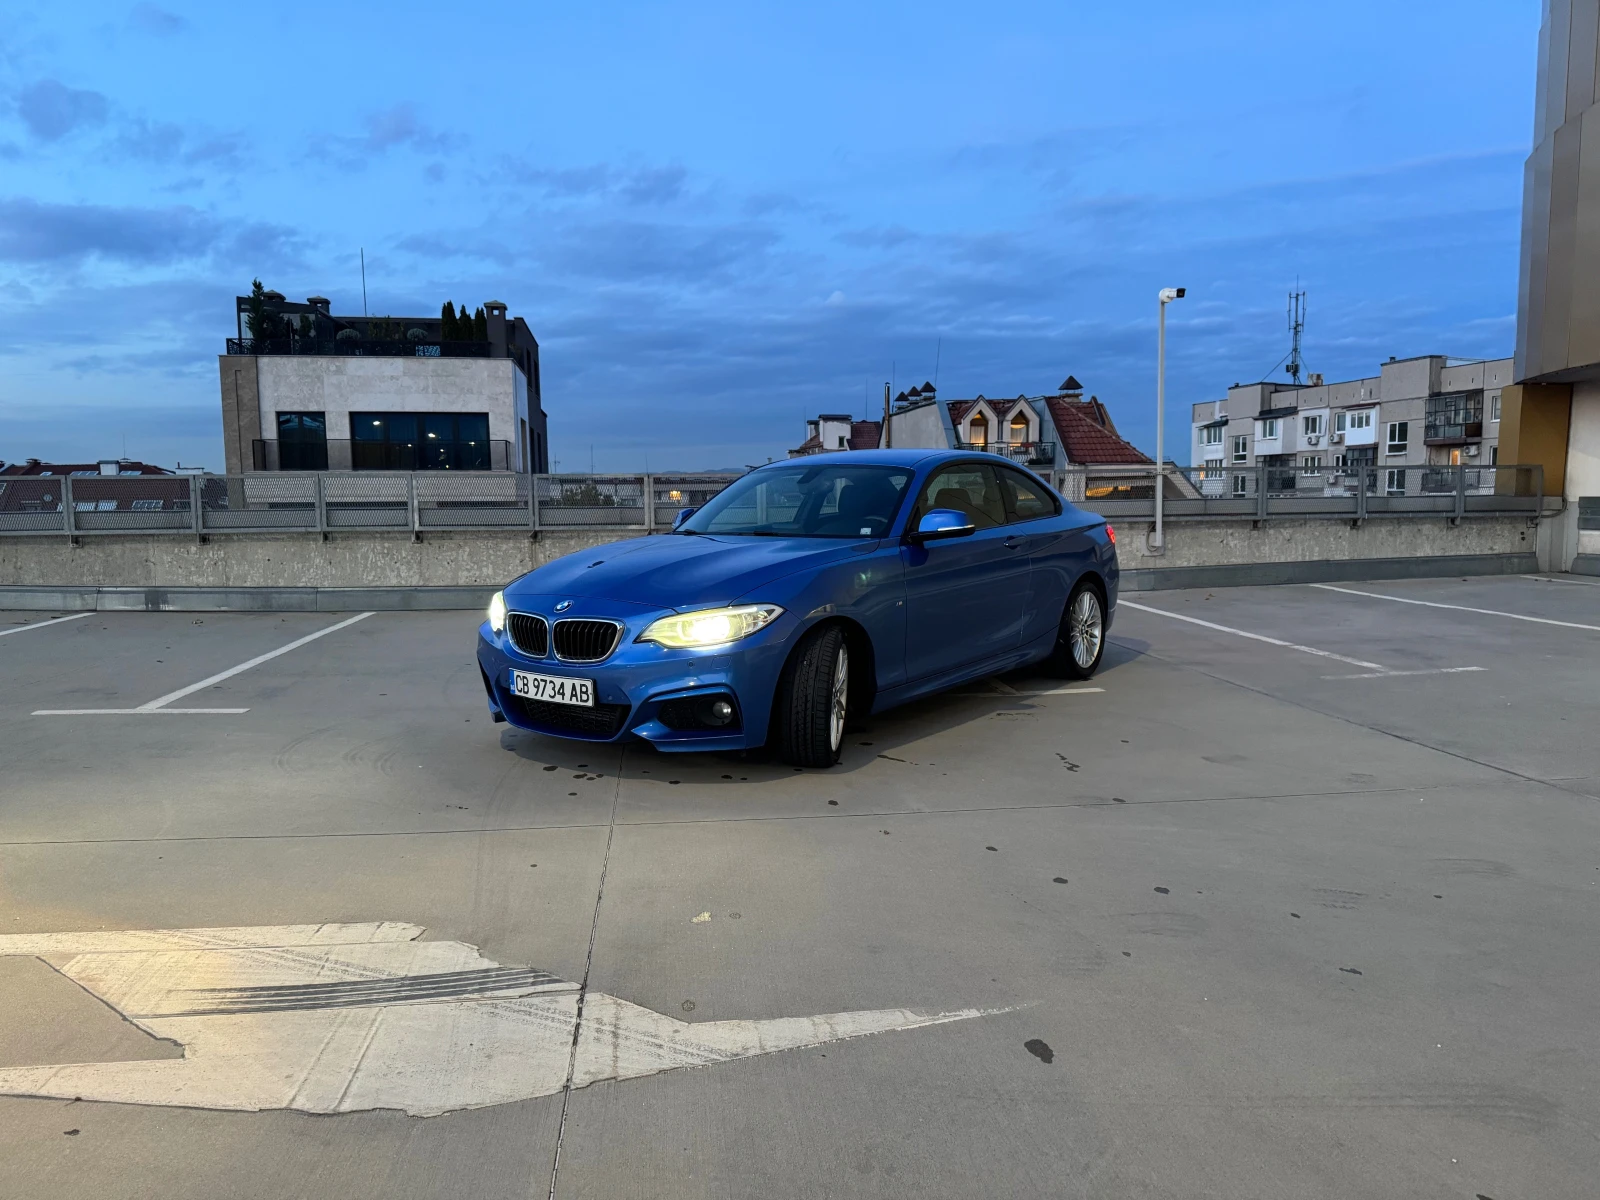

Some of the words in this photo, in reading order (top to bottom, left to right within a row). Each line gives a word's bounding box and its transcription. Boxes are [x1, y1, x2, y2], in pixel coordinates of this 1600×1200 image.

[515, 674, 530, 695] CB
[532, 677, 566, 701] 9734
[569, 682, 590, 703] AB
